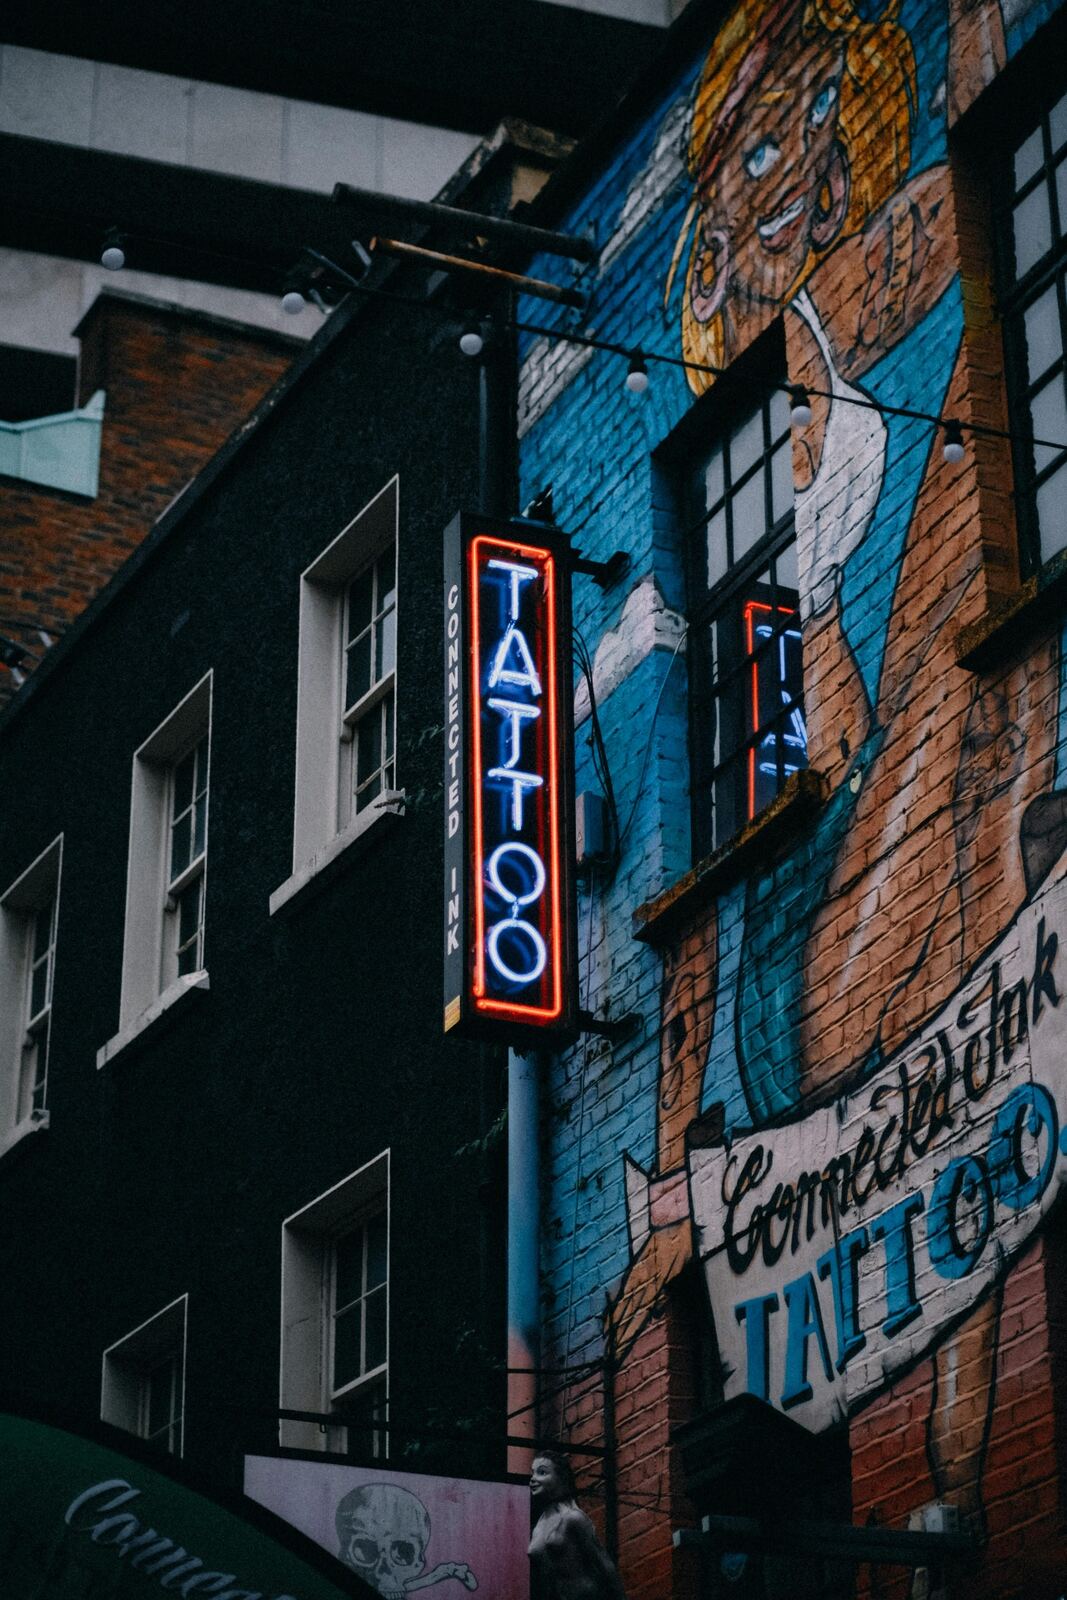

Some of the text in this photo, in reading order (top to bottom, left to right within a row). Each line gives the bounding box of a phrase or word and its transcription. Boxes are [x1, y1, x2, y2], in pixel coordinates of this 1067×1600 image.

[447, 584, 460, 956] CONNECTED INK
[488, 559, 546, 982] TATTOO
[720, 915, 1060, 1276] Connected Ink
[734, 1081, 1059, 1411] TATTOO
[63, 1478, 298, 1600] Conne
